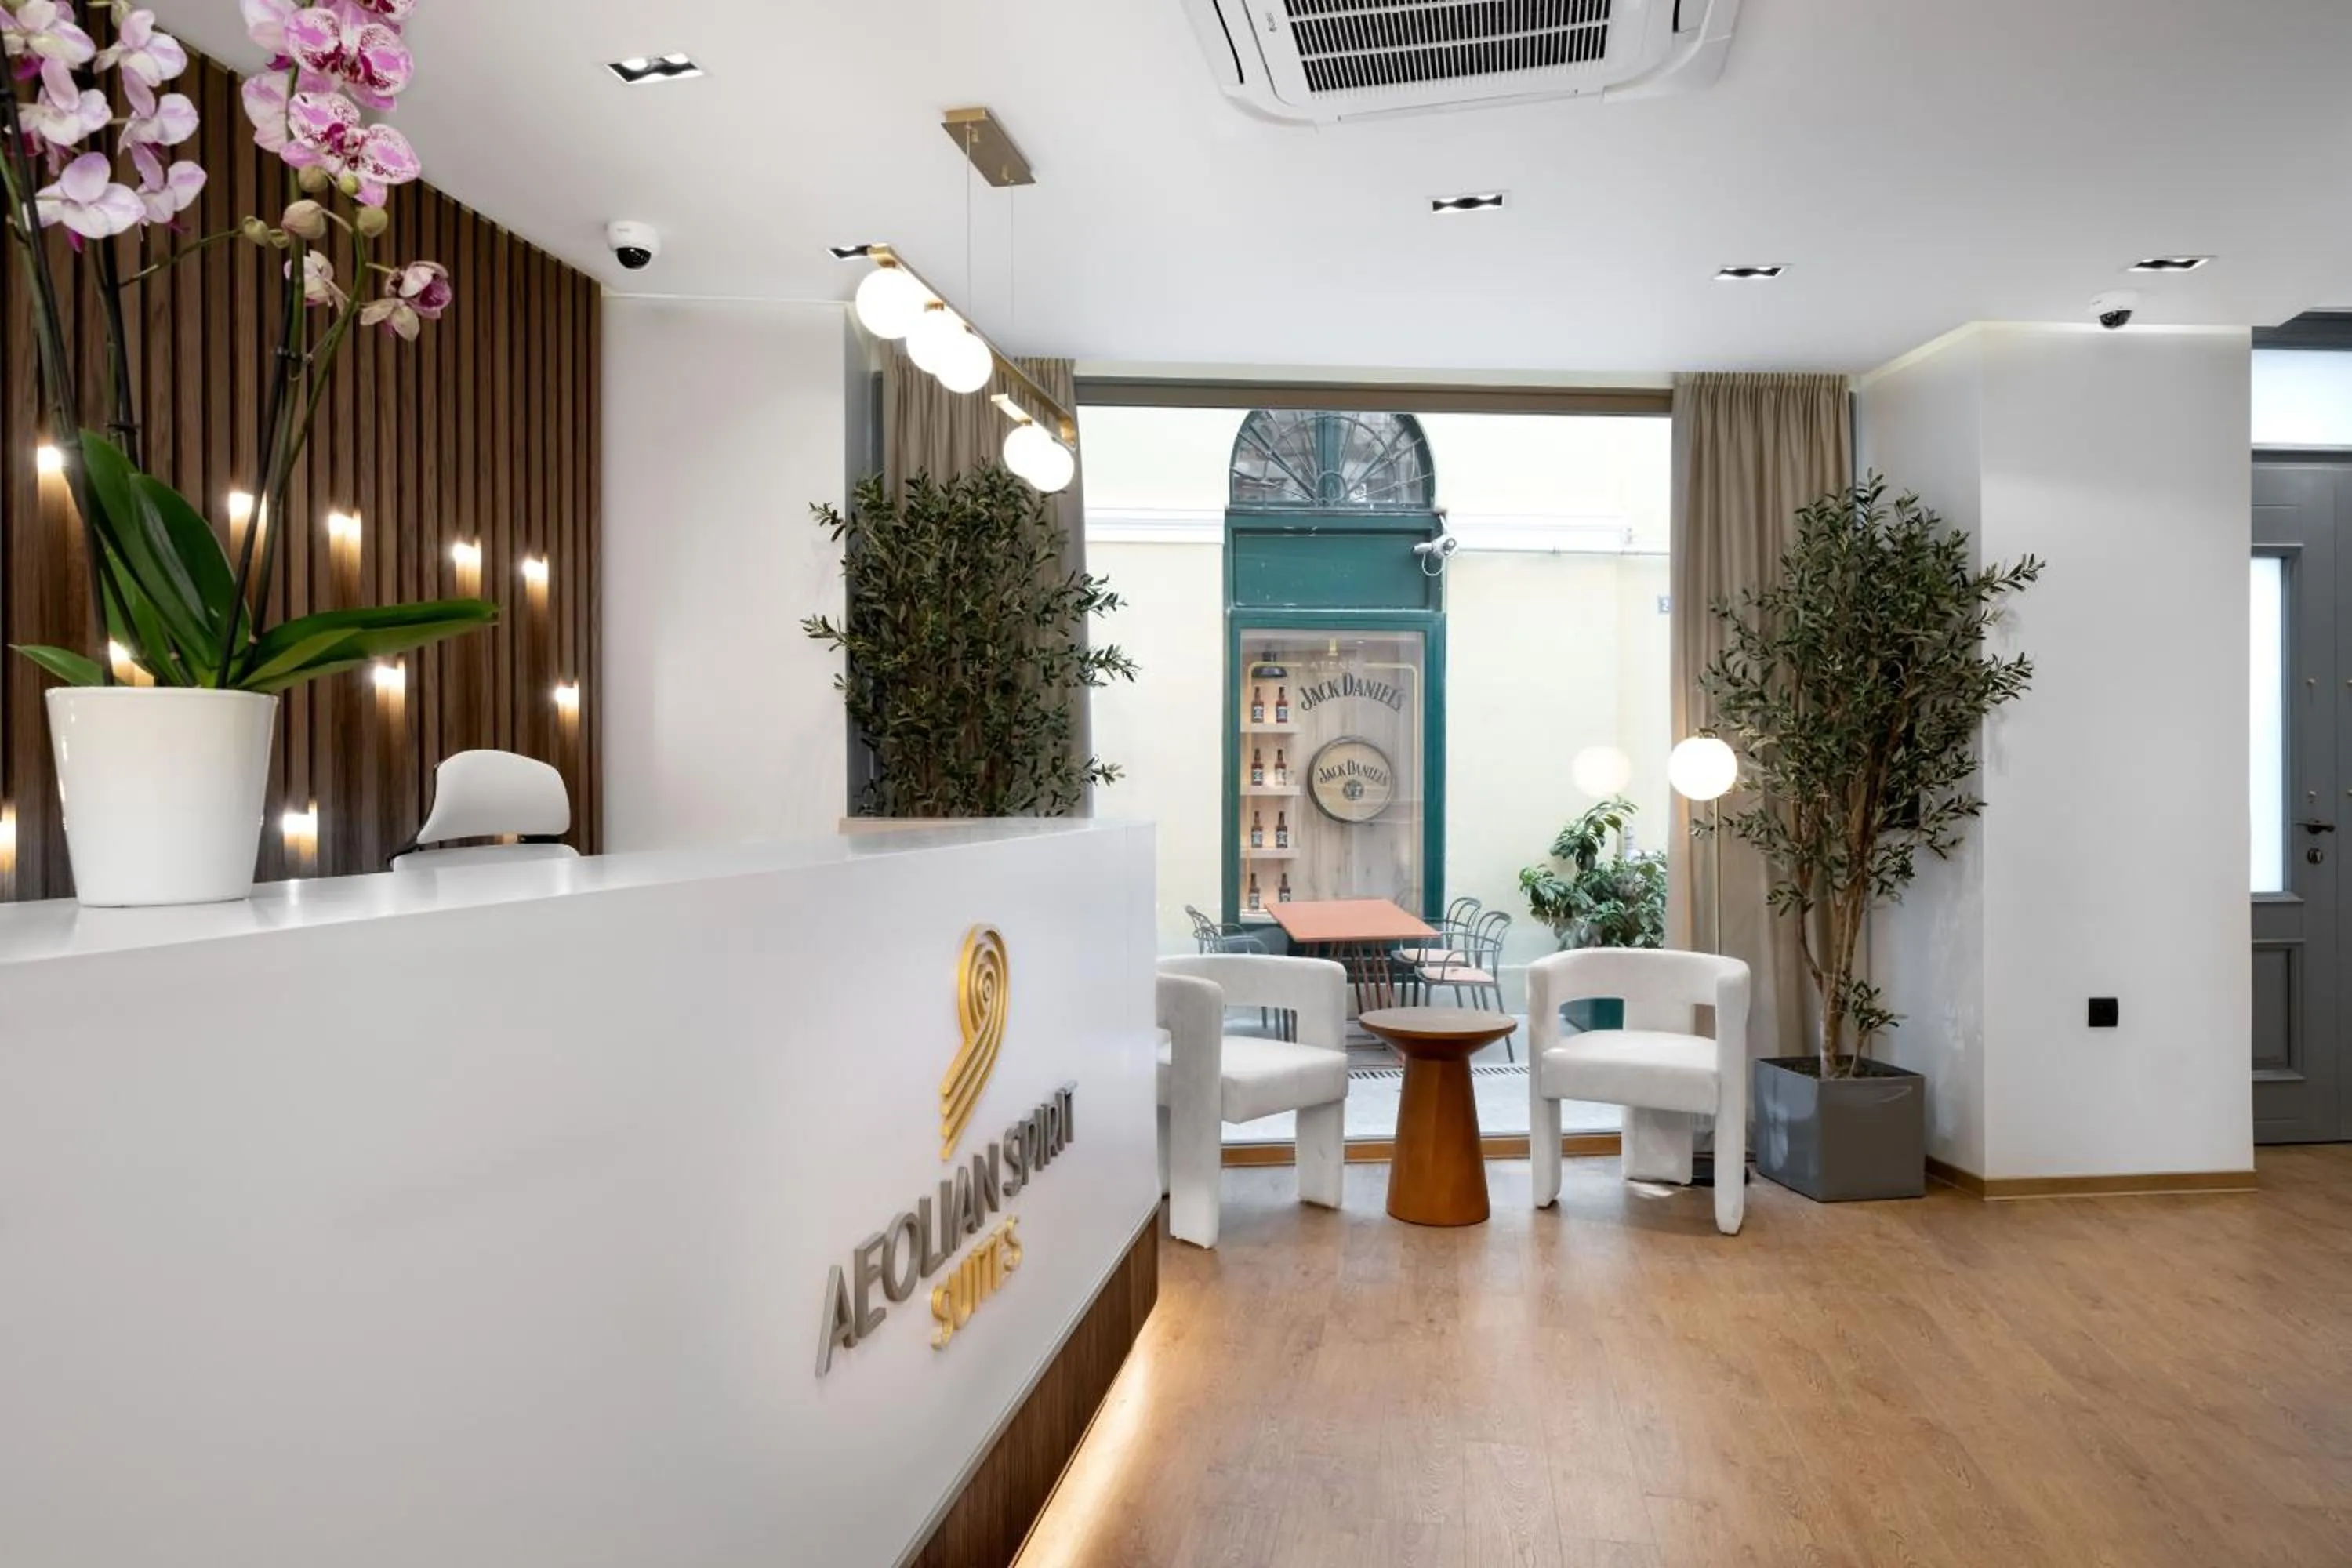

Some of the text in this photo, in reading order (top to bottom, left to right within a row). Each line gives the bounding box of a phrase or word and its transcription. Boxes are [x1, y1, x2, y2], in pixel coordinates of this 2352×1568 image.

[1299, 679, 1340, 711] JACK
[1319, 764, 1346, 784] JACK
[815, 1080, 1078, 1378] AEOLIAN SPIRIT
